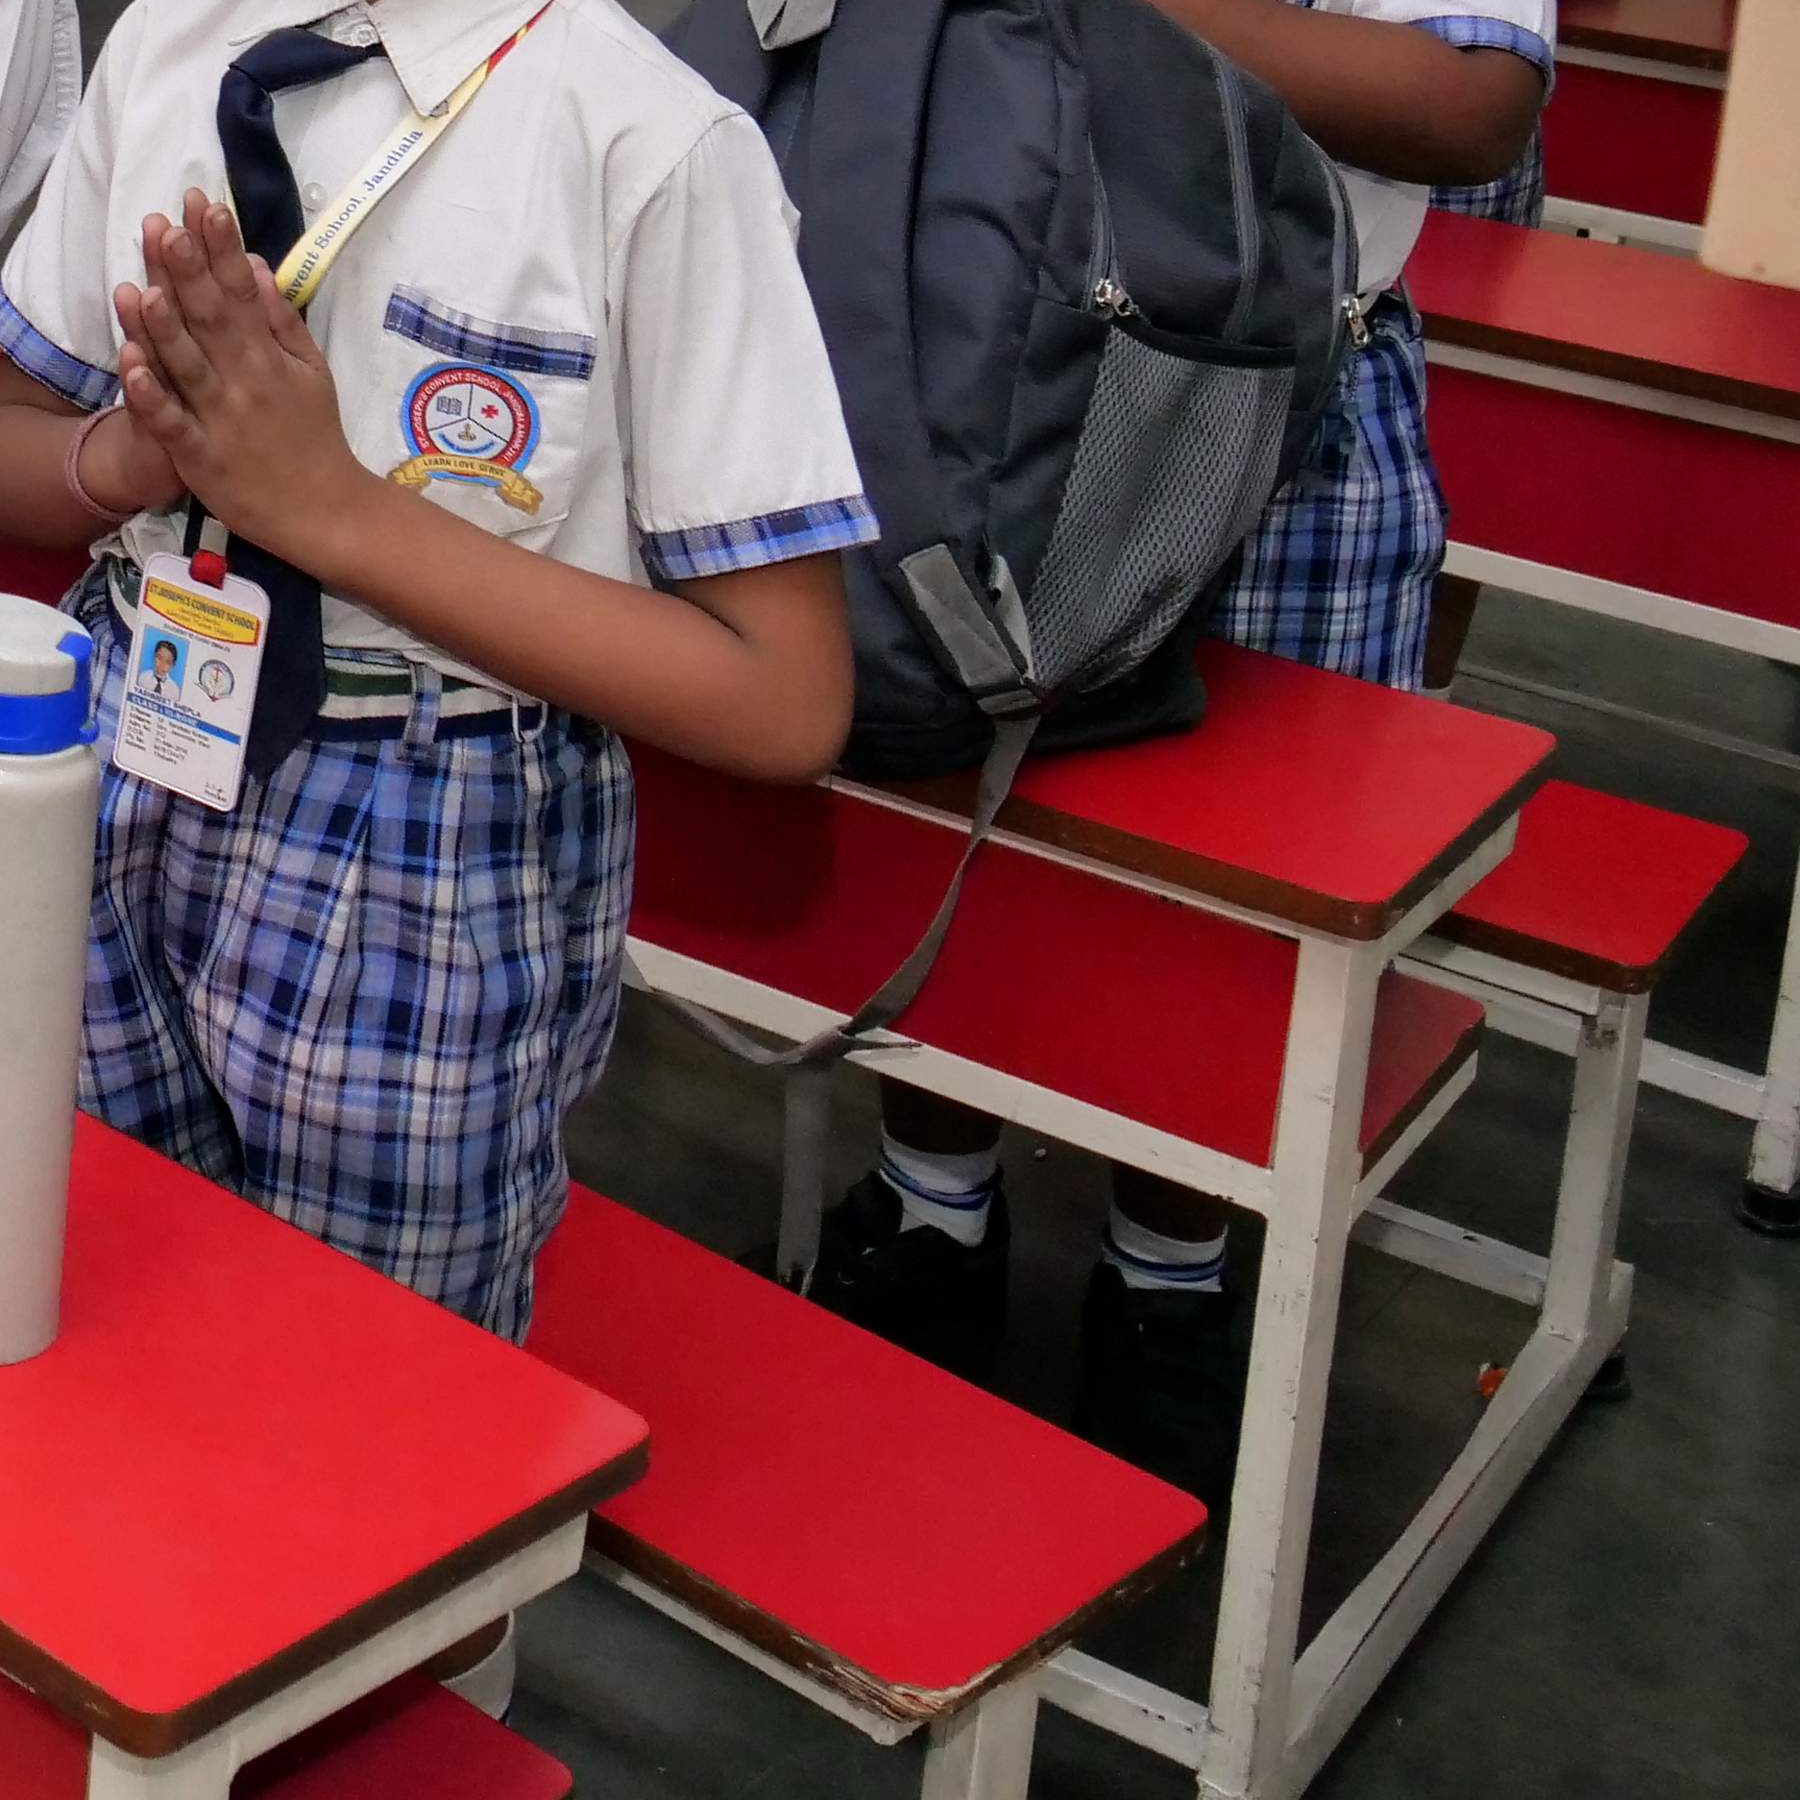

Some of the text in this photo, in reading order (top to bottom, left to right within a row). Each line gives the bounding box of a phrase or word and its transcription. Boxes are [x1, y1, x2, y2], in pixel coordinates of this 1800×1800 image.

[314, 197, 368, 250] School,
[362, 129, 424, 192] Jandiala
[422, 373, 464, 395] CONVENT
[423, 458, 451, 467] LEARN
[453, 460, 475, 470] LOVE
